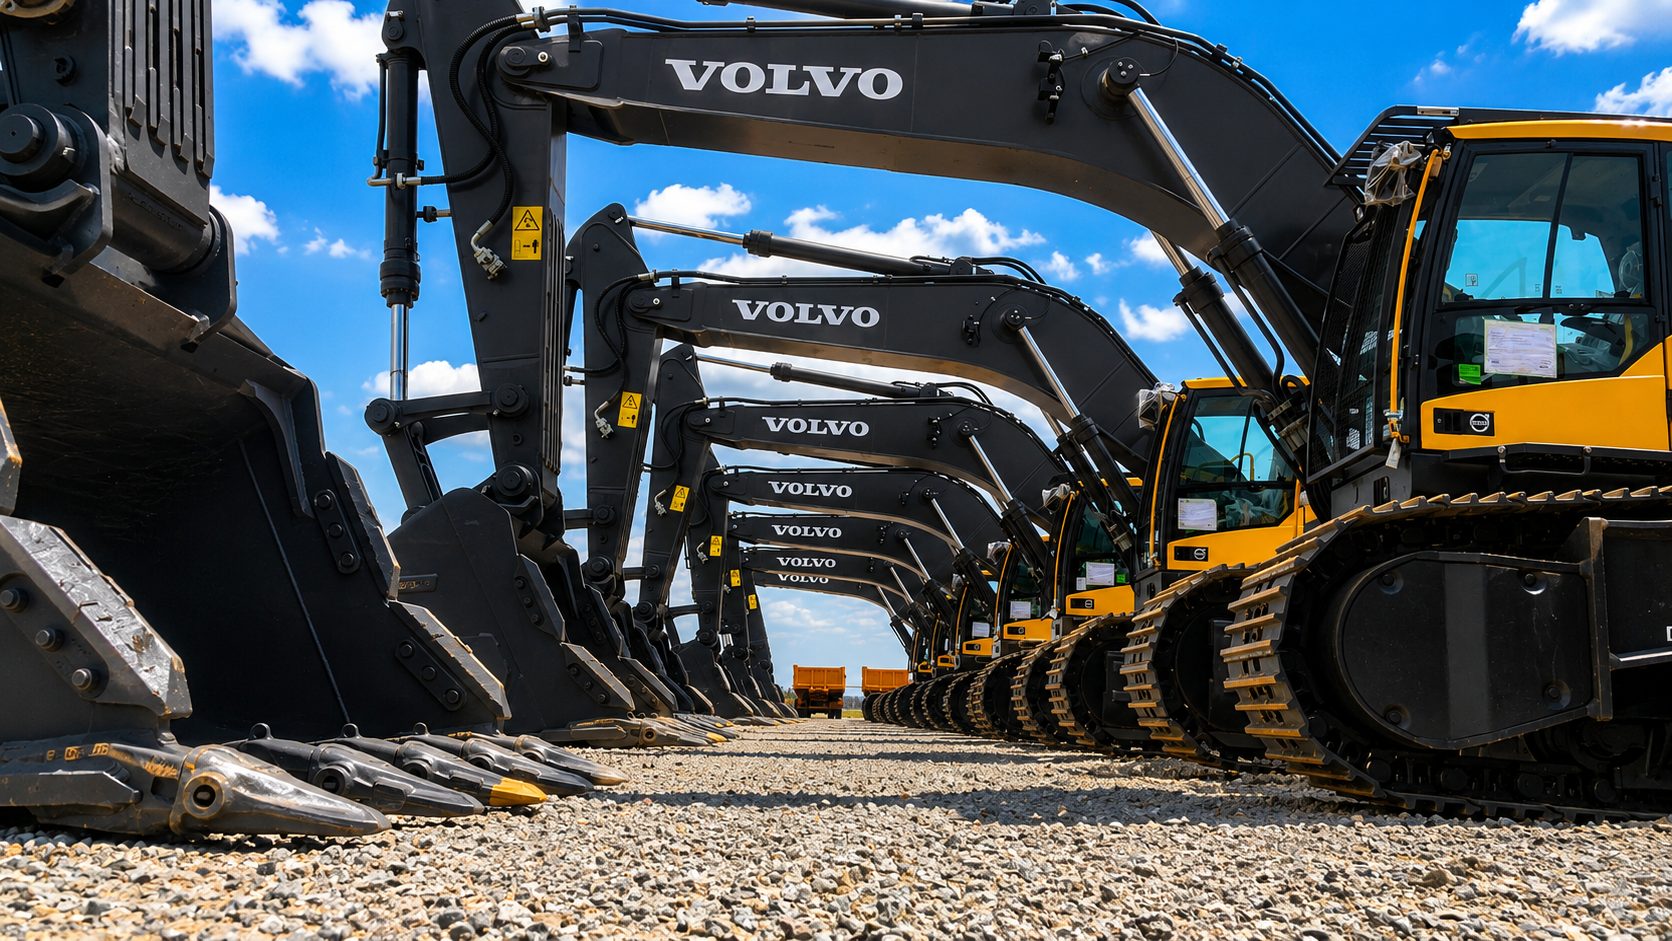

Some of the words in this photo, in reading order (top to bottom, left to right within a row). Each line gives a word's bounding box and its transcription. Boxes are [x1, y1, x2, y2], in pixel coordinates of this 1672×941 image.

[665, 59, 903, 100] VOLVO
[732, 299, 880, 327] VOLVO
[762, 417, 870, 437] VOLVO
[768, 480, 853, 498] VOLVO
[772, 524, 842, 539] VOLVO
[776, 556, 837, 568] VOLVO
[777, 573, 829, 583] VOLVO
